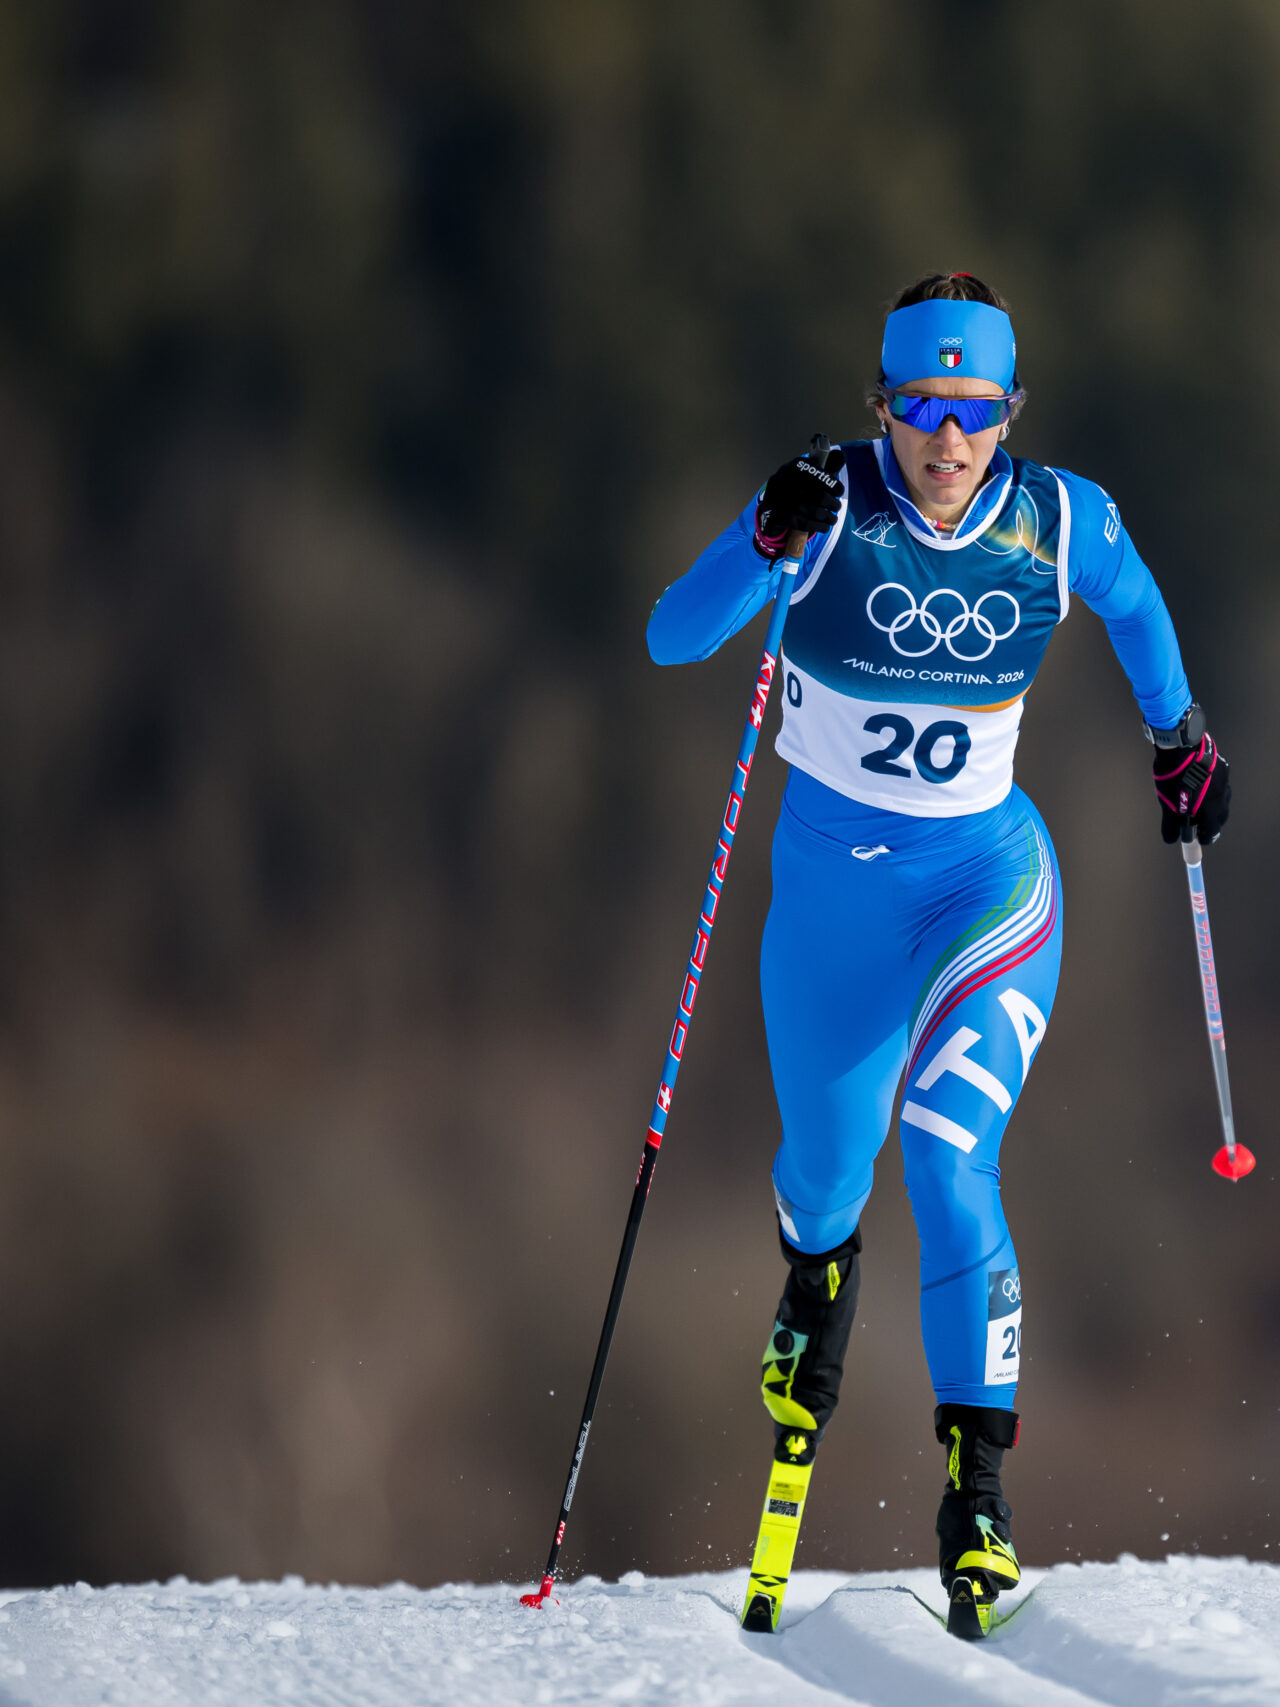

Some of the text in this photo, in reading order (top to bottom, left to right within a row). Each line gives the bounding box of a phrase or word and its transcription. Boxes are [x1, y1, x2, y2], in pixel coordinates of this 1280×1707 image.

[796, 460, 838, 489] sportful
[1096, 484, 1118, 544] EA
[842, 657, 1025, 685] MILANO CORTINA 2026
[860, 712, 972, 785] 20
[669, 752, 754, 1062] TORNADO
[901, 987, 1047, 1154] ITA
